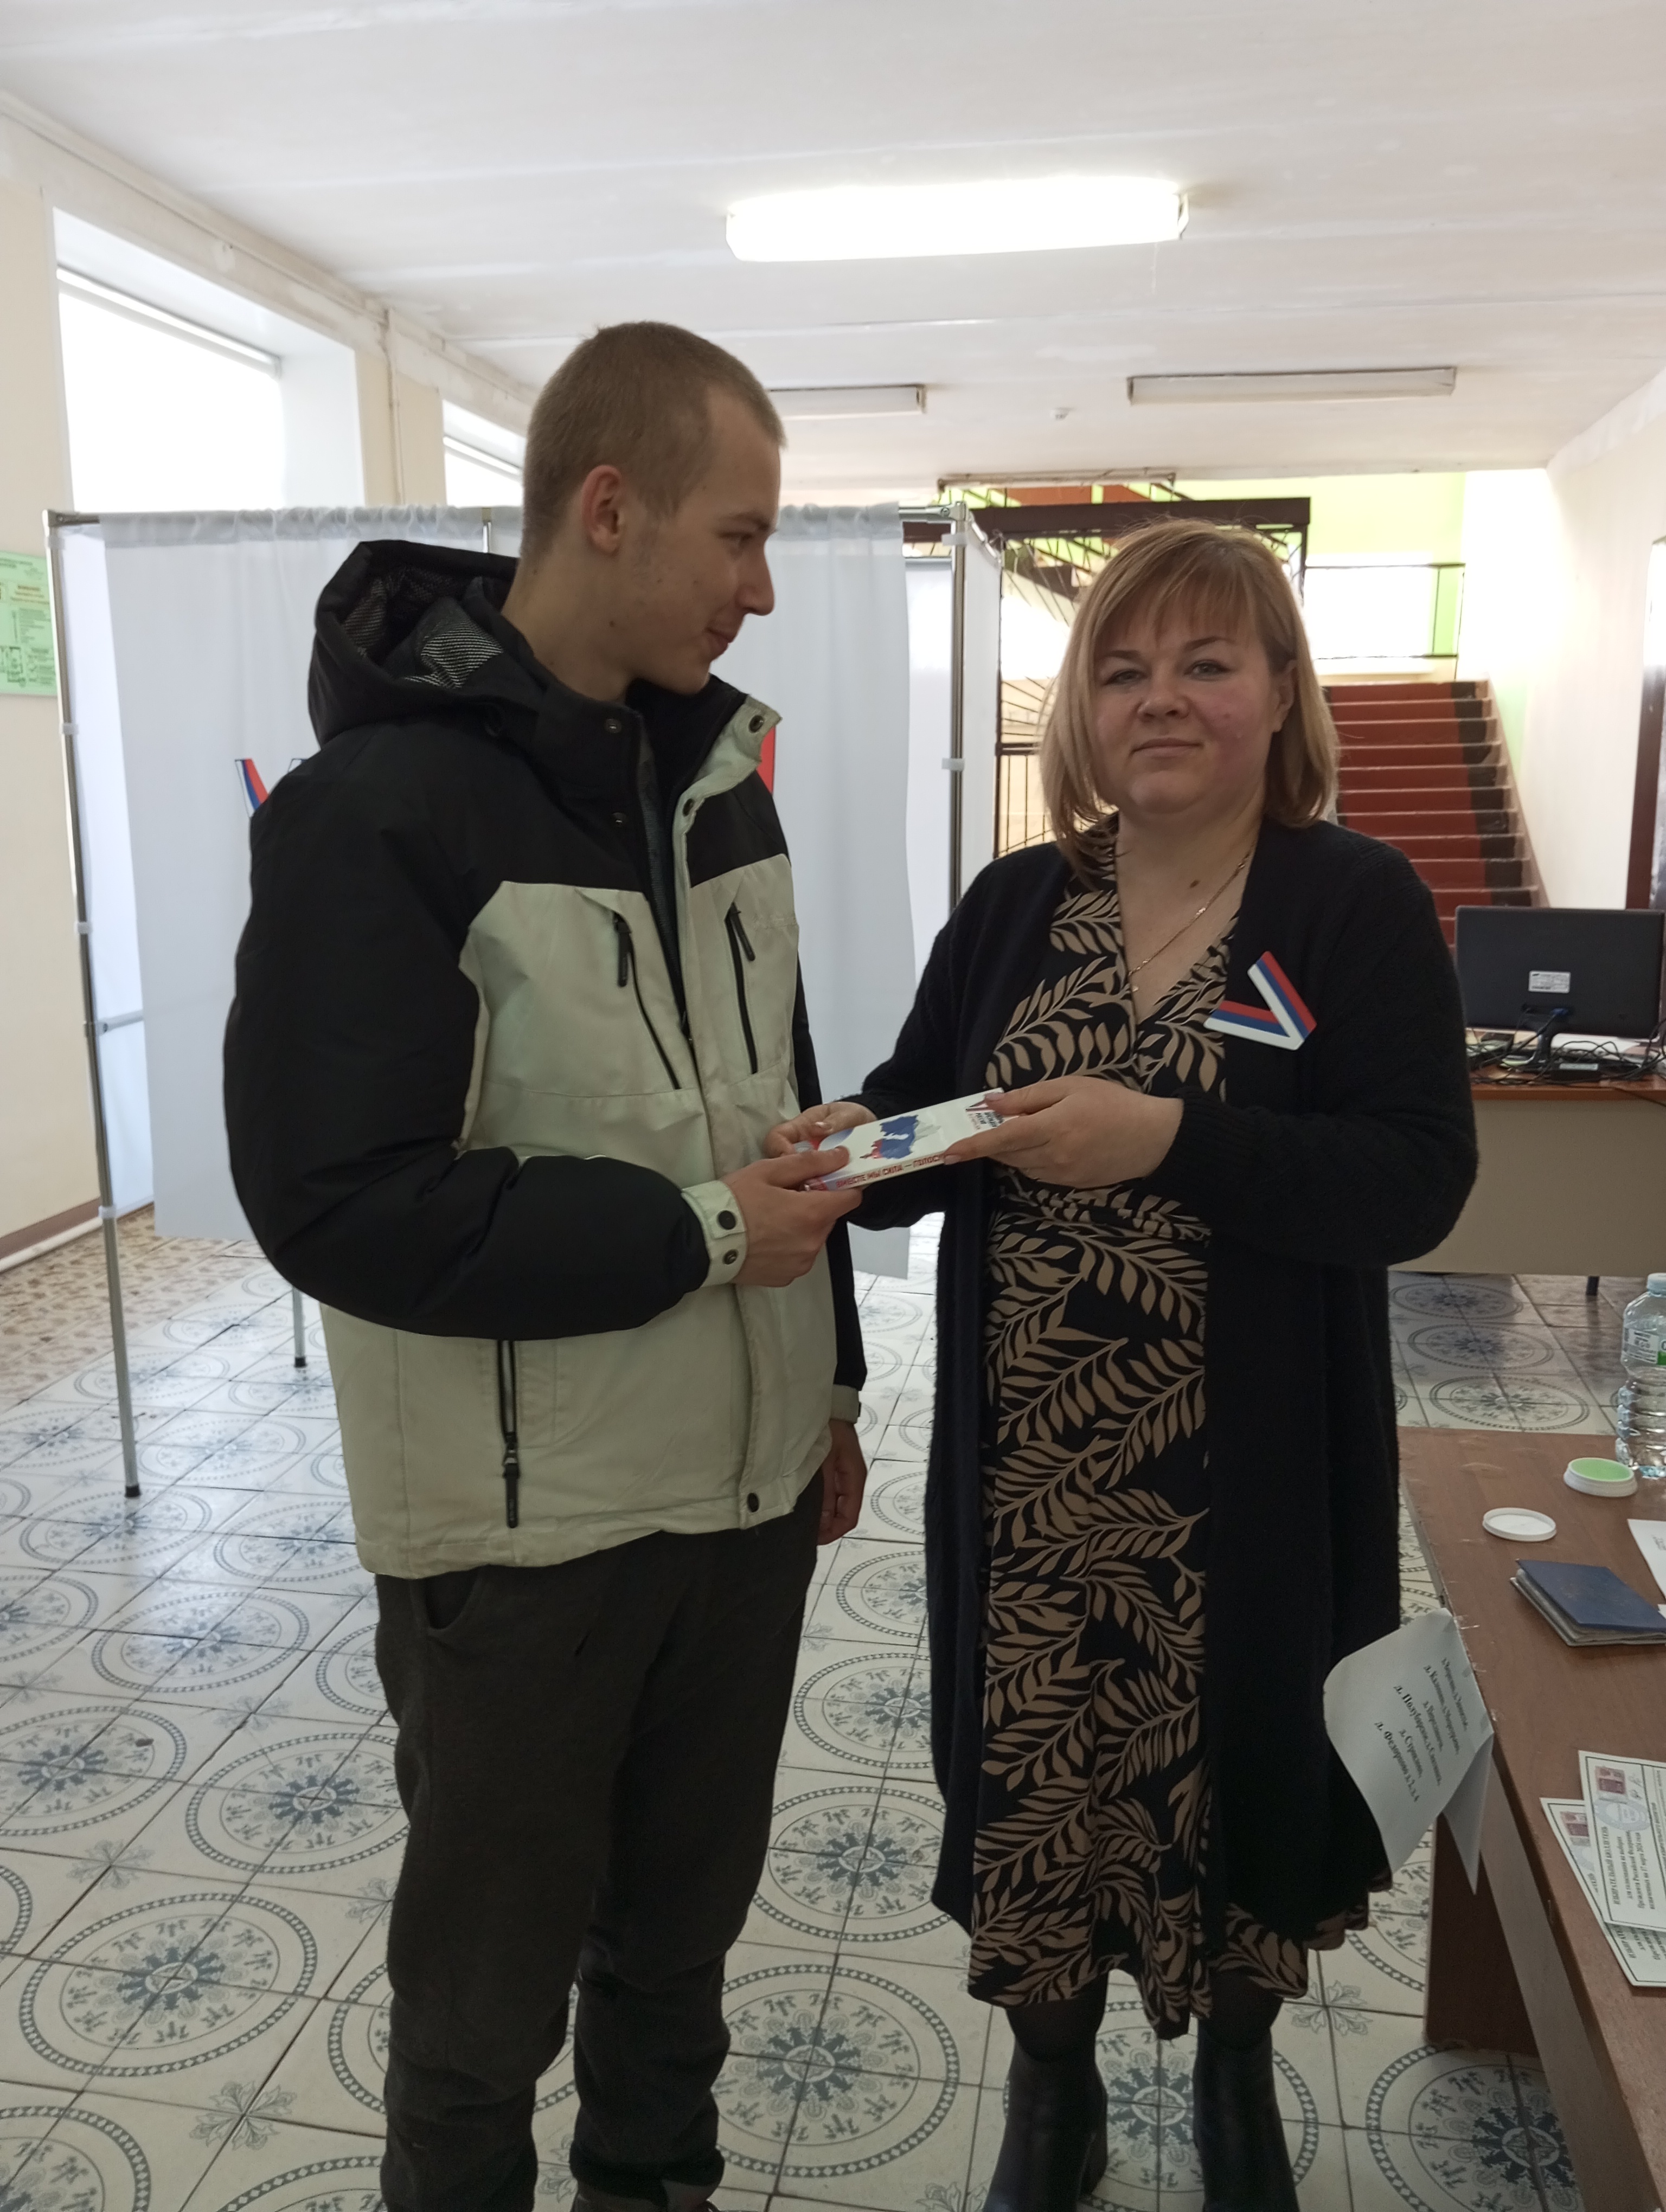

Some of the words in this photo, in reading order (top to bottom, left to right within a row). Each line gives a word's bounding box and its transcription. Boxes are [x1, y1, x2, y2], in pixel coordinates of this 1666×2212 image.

[836, 1174, 866, 1187] ВМЕСТЕ
[867, 1171, 881, 1179] МЫ
[882, 1165, 904, 1175] СИЛА
